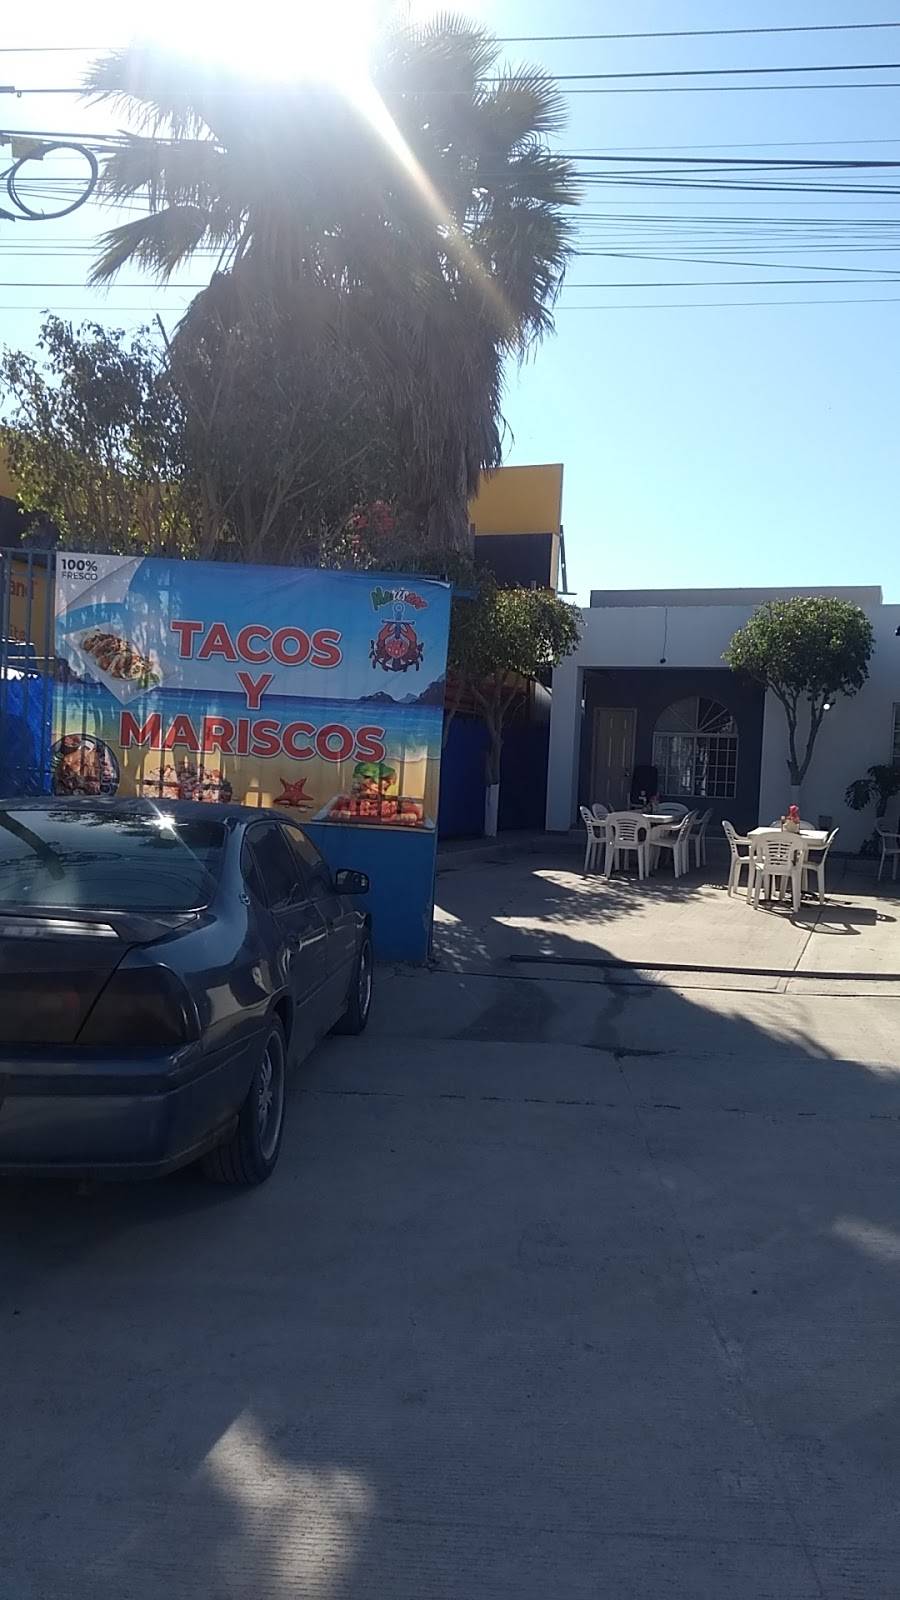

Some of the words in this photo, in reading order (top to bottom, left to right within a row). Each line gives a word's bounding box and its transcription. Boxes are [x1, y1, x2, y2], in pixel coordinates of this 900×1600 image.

[61, 559, 98, 571] 100%
[61, 571, 98, 581] FRESCO
[170, 620, 342, 668] TACOS
[236, 671, 273, 709] Y
[119, 711, 386, 763] MARISCOS
